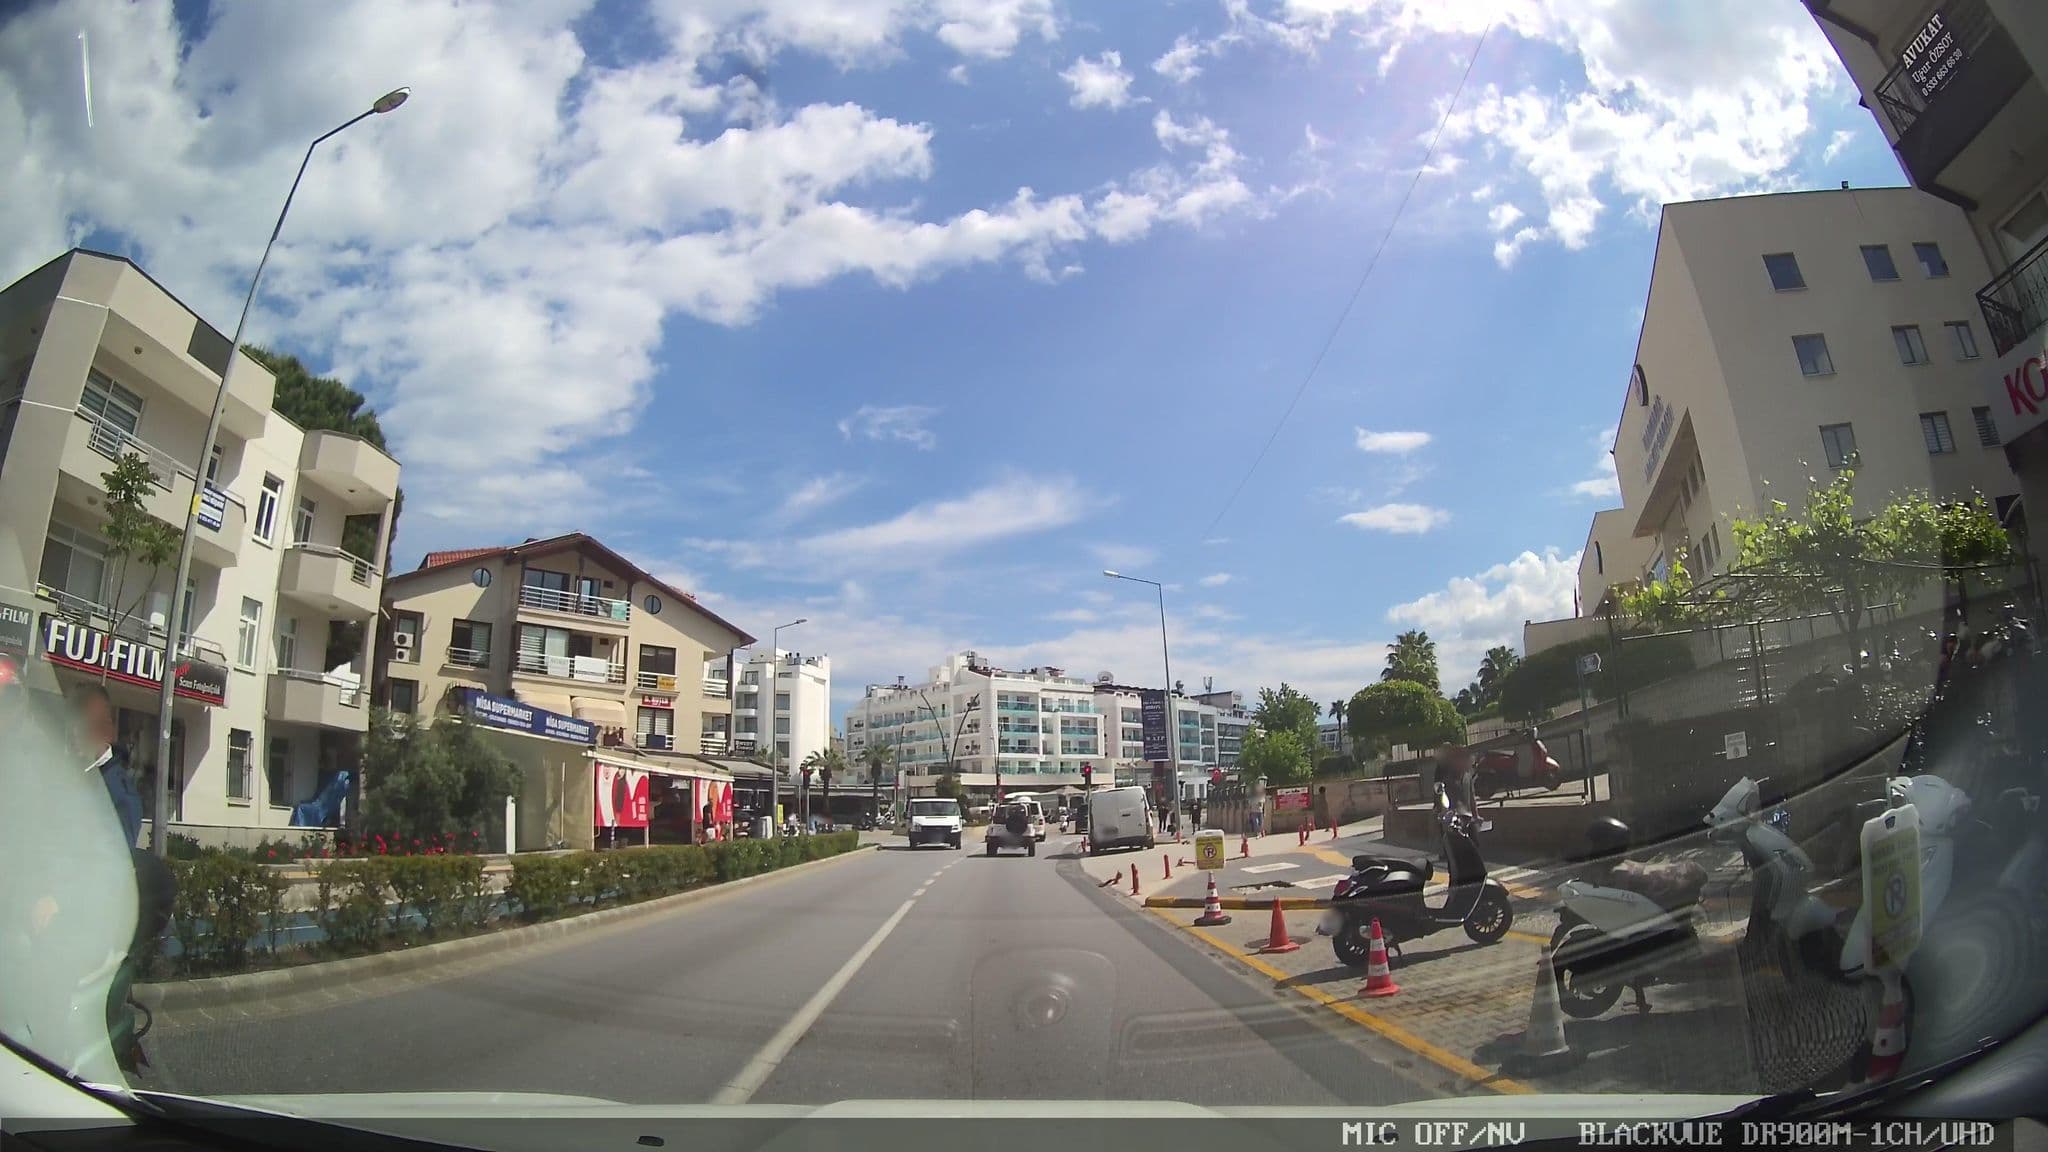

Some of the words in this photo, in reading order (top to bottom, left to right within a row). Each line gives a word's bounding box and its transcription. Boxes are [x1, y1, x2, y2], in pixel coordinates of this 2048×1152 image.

[1902, 13, 1944, 69] AVUKAT
[1929, 31, 1954, 63] ÖZSOY
[0, 607, 29, 625] FILM
